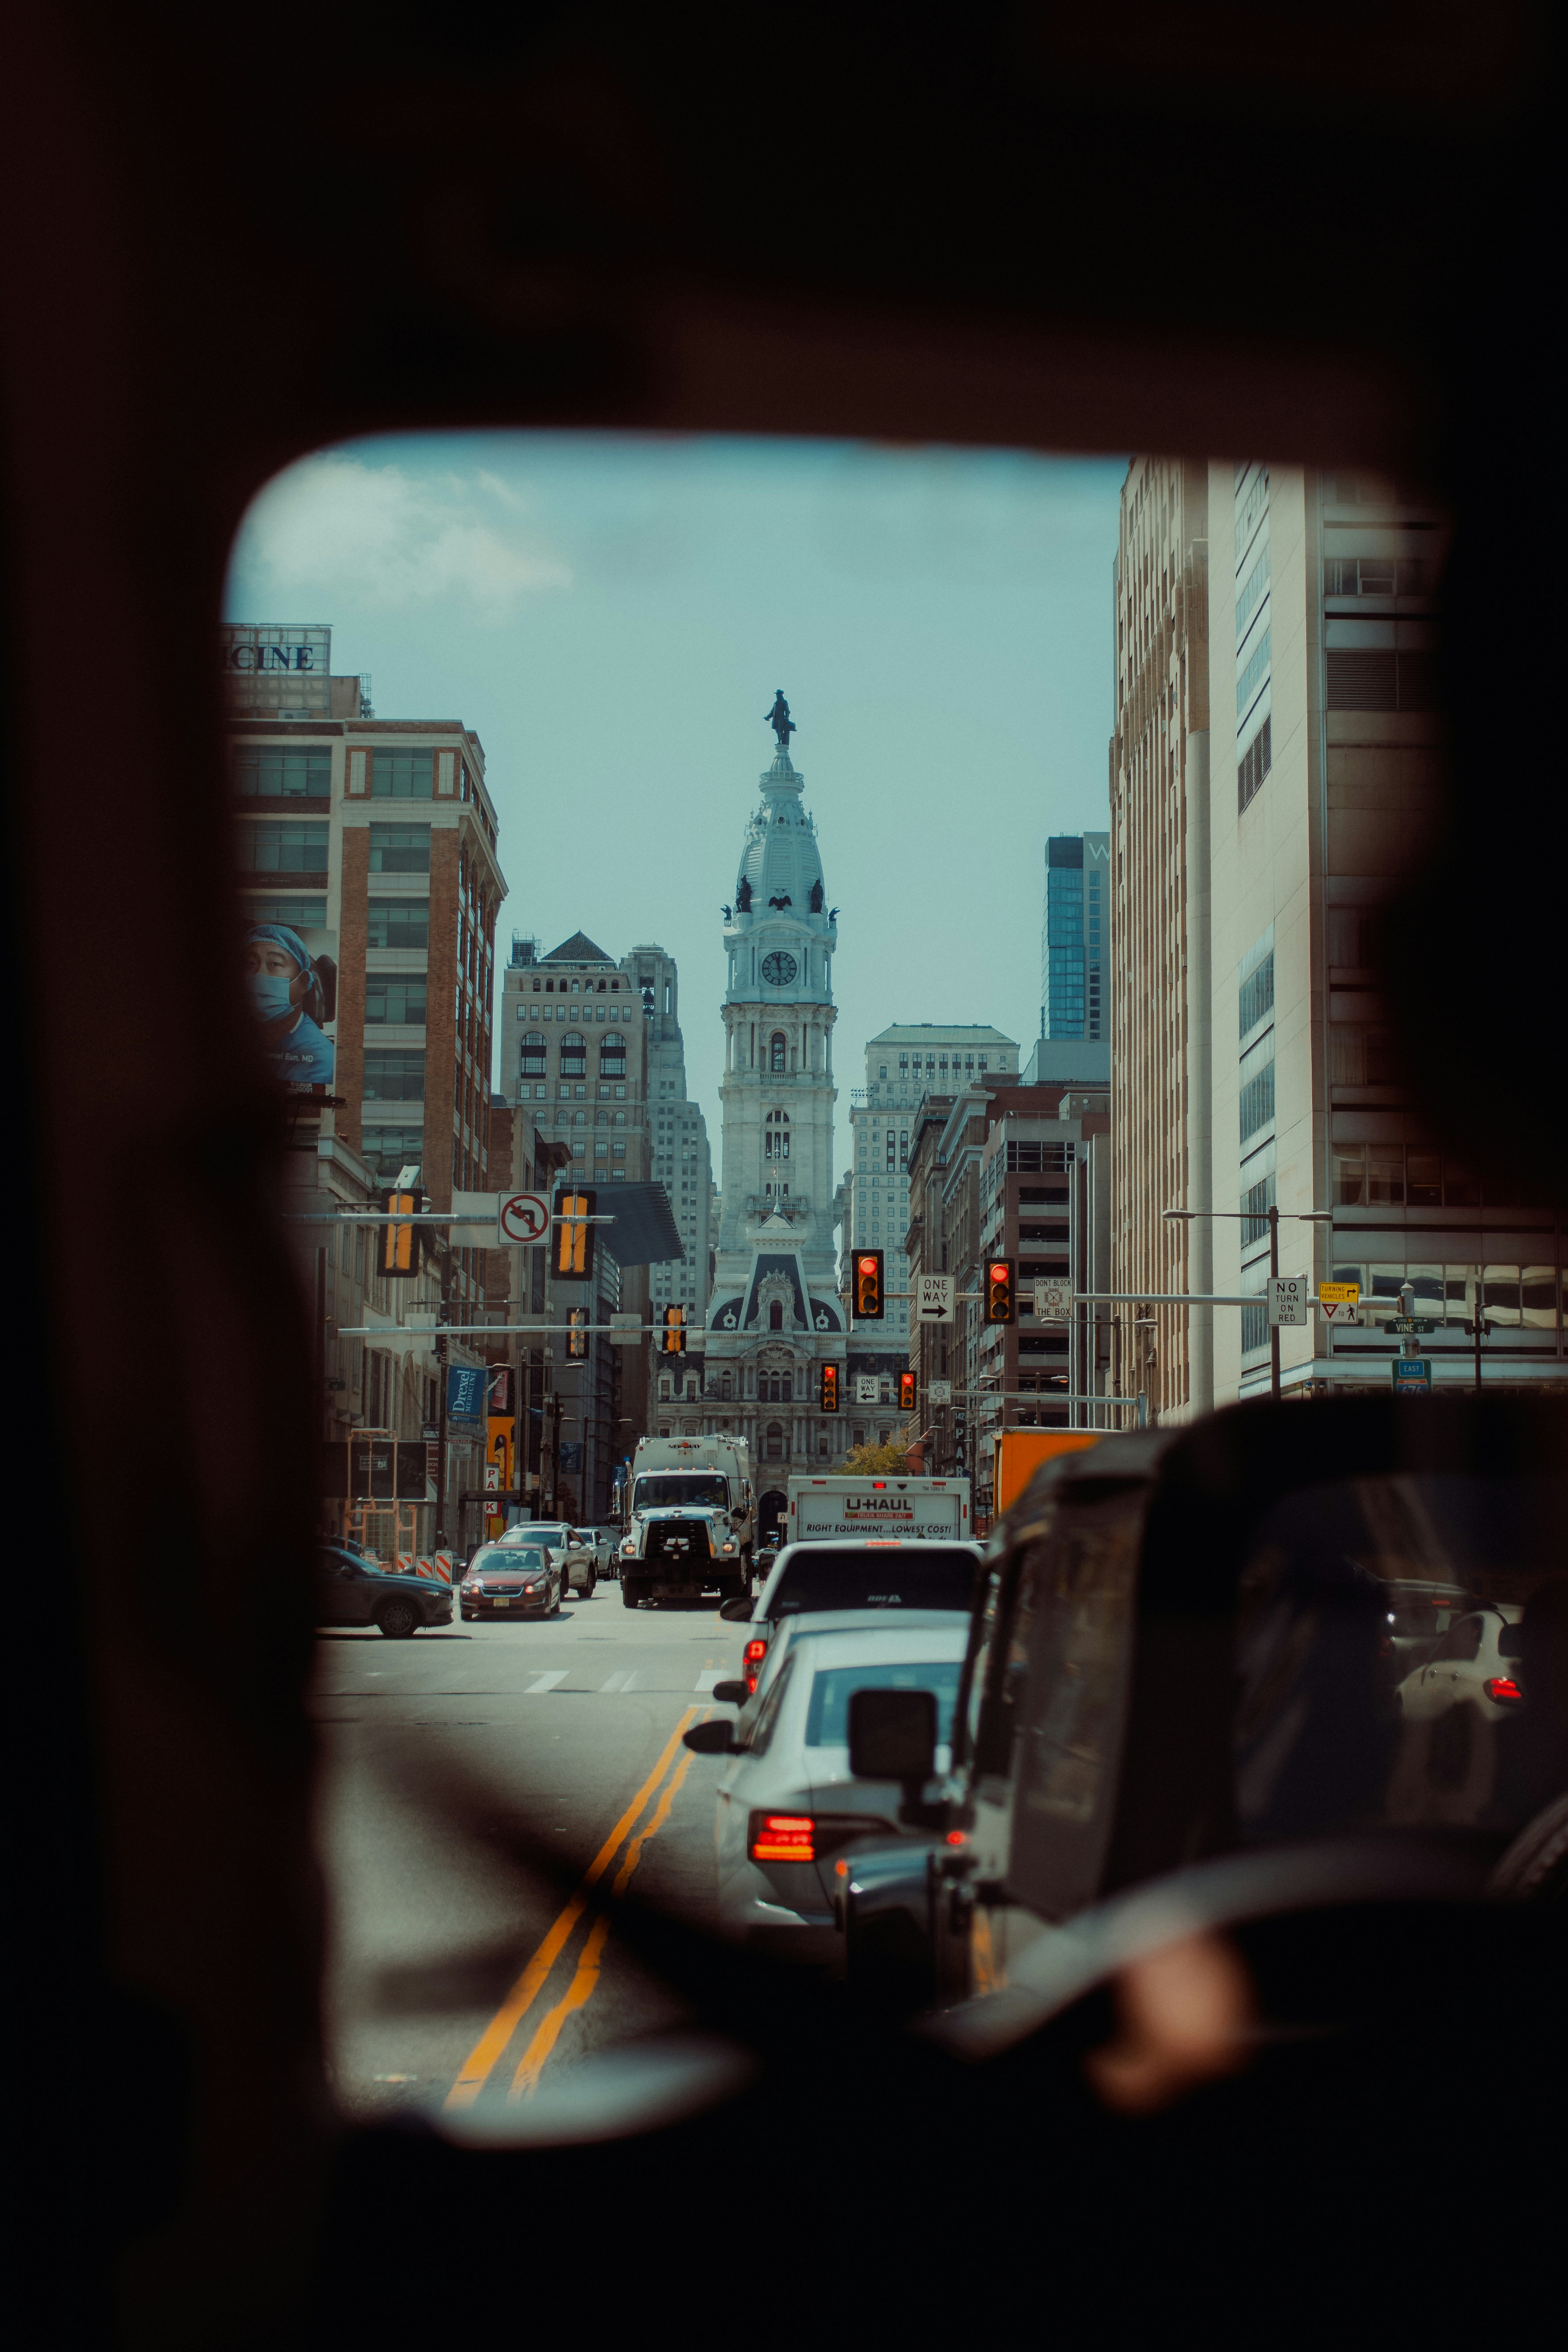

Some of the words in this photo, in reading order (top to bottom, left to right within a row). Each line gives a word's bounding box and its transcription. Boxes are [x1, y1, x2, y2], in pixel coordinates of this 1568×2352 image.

[223, 646, 313, 670] CINE
[924, 1279, 948, 1290] ONE
[1277, 1282, 1297, 1293] NO
[923, 1291, 948, 1302] WAY
[1396, 1323, 1414, 1332] VINE
[452, 1370, 470, 1413] Drexel
[465, 1371, 477, 1413] MEDICINE
[955, 1428, 964, 1478] PAR
[485, 1470, 496, 1512] PAK
[847, 1498, 912, 1510] U-HAUL
[806, 1524, 832, 1532] RIGHT
